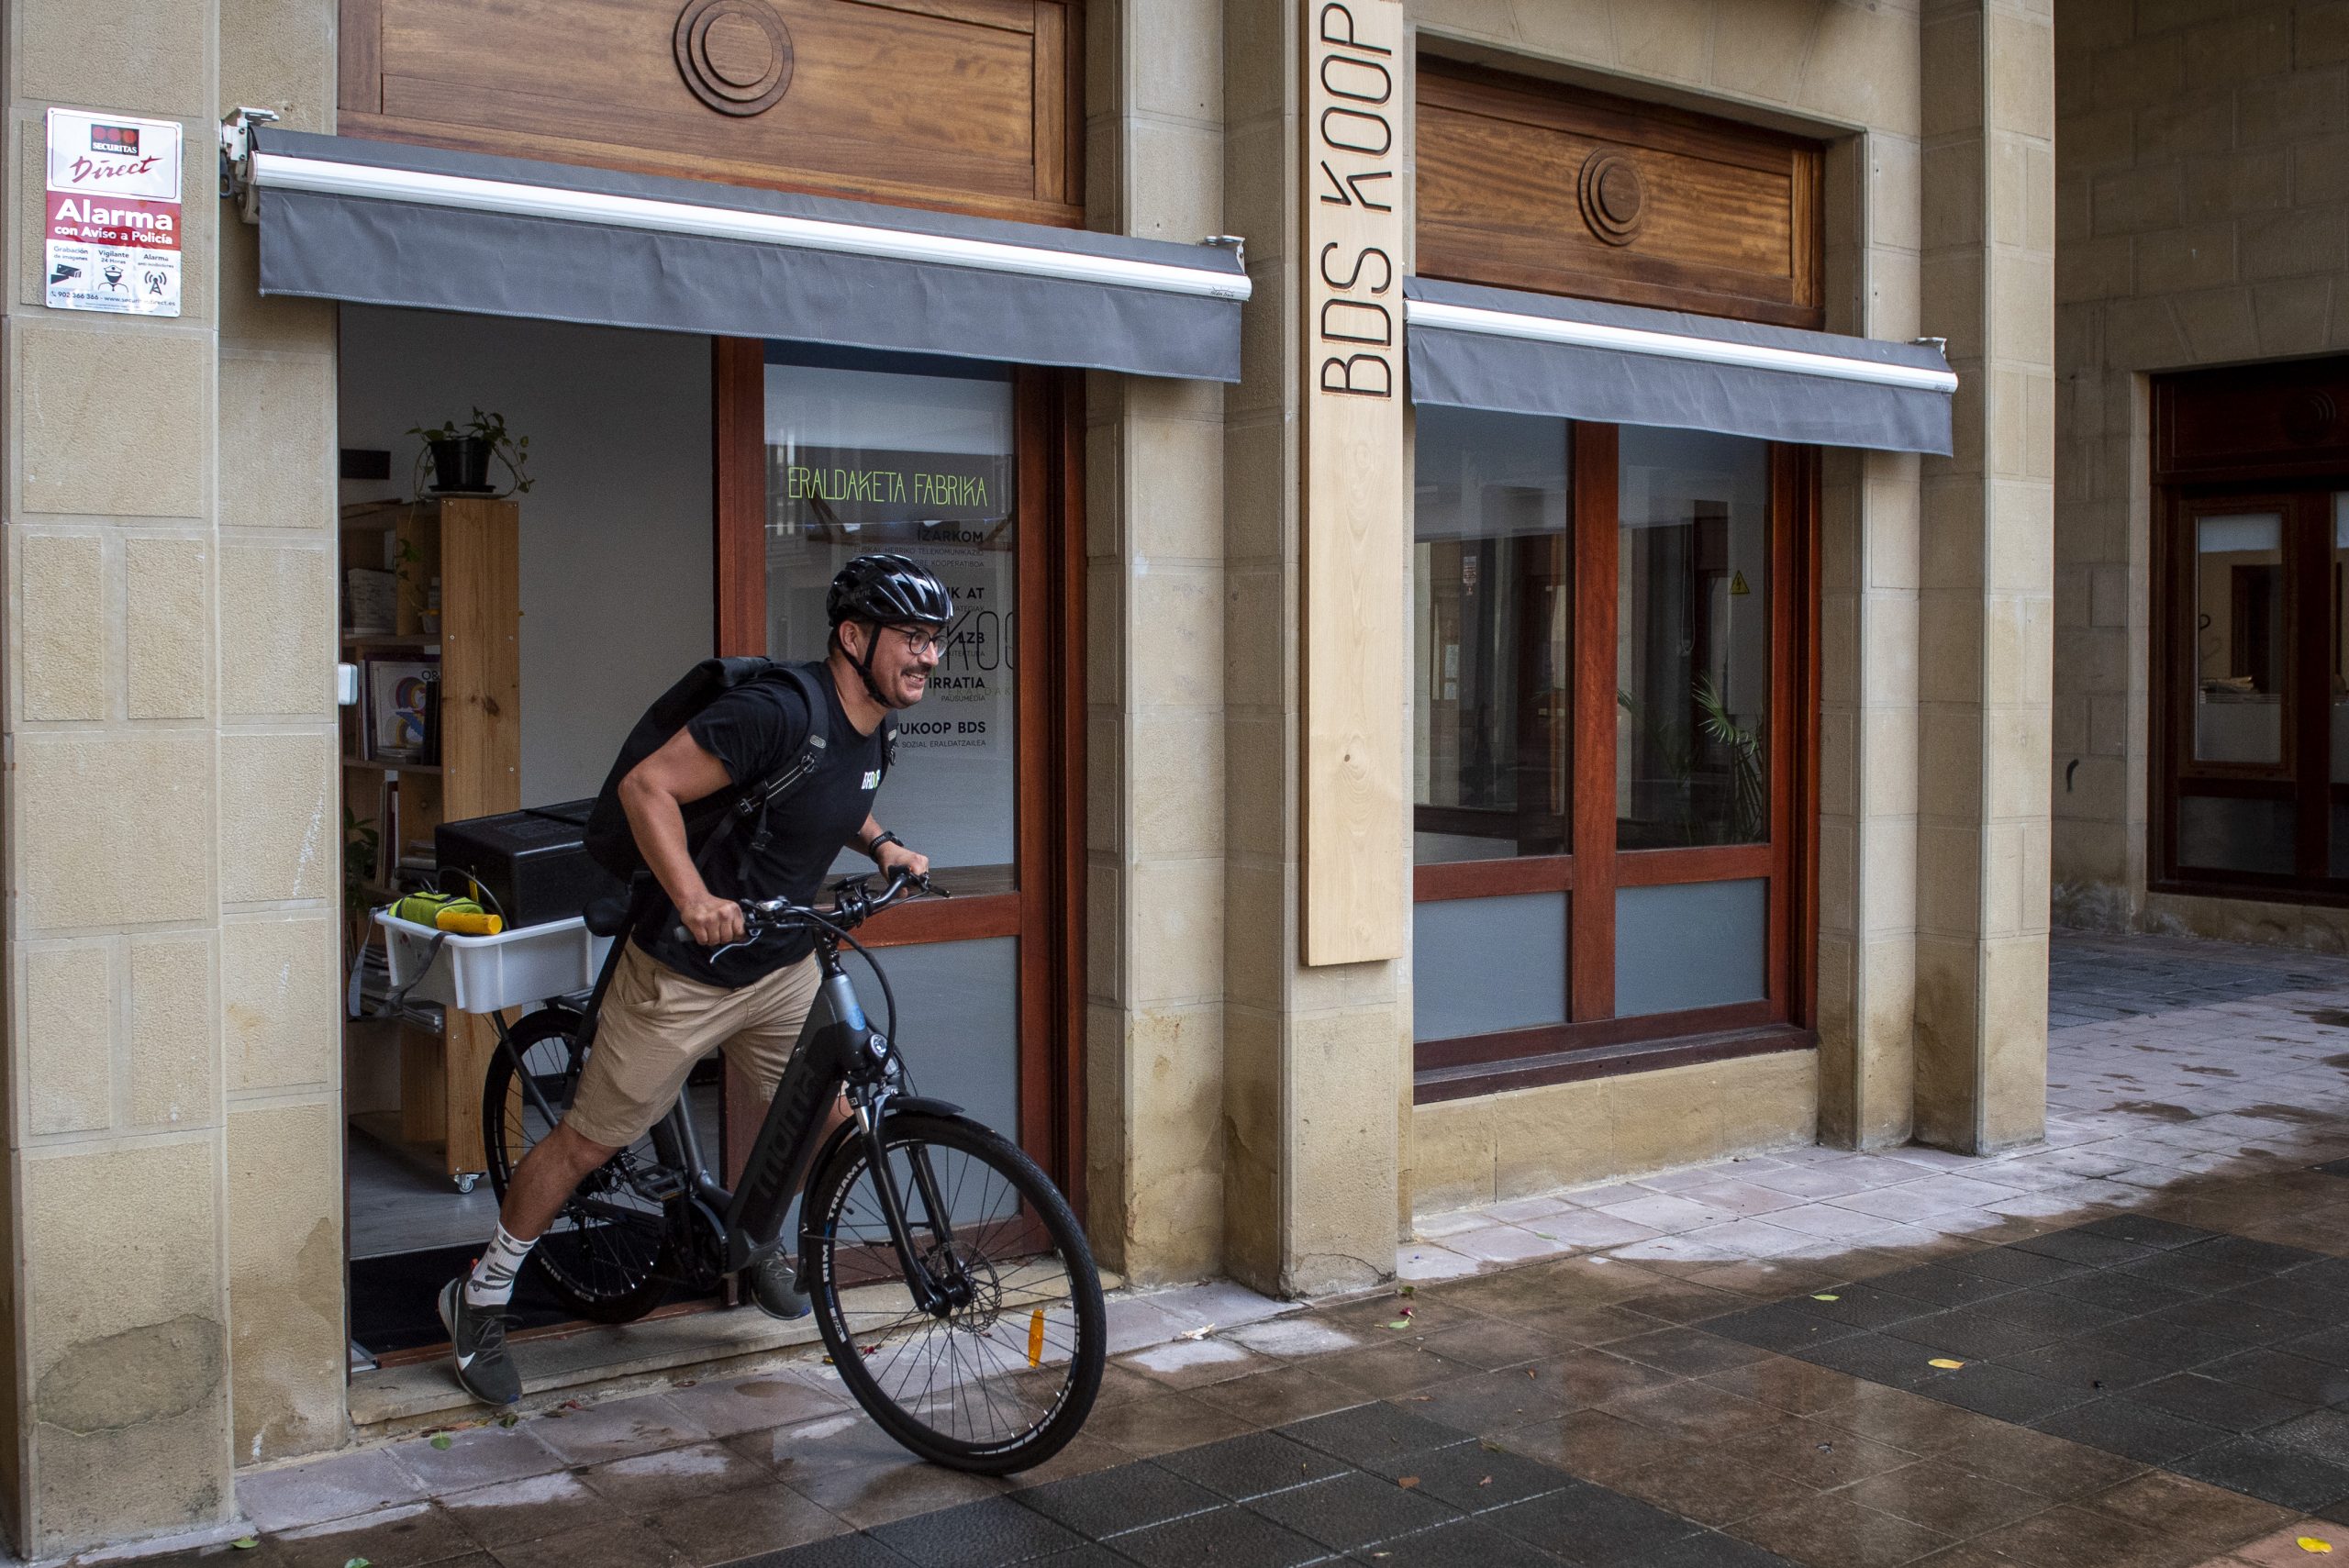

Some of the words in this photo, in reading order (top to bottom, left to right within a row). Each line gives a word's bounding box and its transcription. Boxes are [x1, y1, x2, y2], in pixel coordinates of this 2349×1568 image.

[1320, 2, 1392, 213] KOOP
[92, 142, 138, 154] SECURITAS
[69, 155, 163, 183] Direct
[55, 198, 173, 231] Alarma
[55, 227, 79, 236] con
[81, 227, 117, 239] Aviso
[120, 232, 128, 240] a
[132, 230, 173, 245] Policía
[98, 250, 130, 260] Vigilante
[72, 292, 85, 300] 366
[1320, 241, 1392, 398] BDS
[788, 466, 907, 504] ERALDAKETA
[914, 473, 988, 506] FABRIKA
[918, 529, 984, 543] IZARKOM
[966, 586, 985, 599] AT
[929, 676, 985, 689] IRRATIA
[957, 721, 986, 734] BDS
[901, 740, 928, 749] SOZIAL
[930, 739, 986, 748] ERALDATZAILEA
